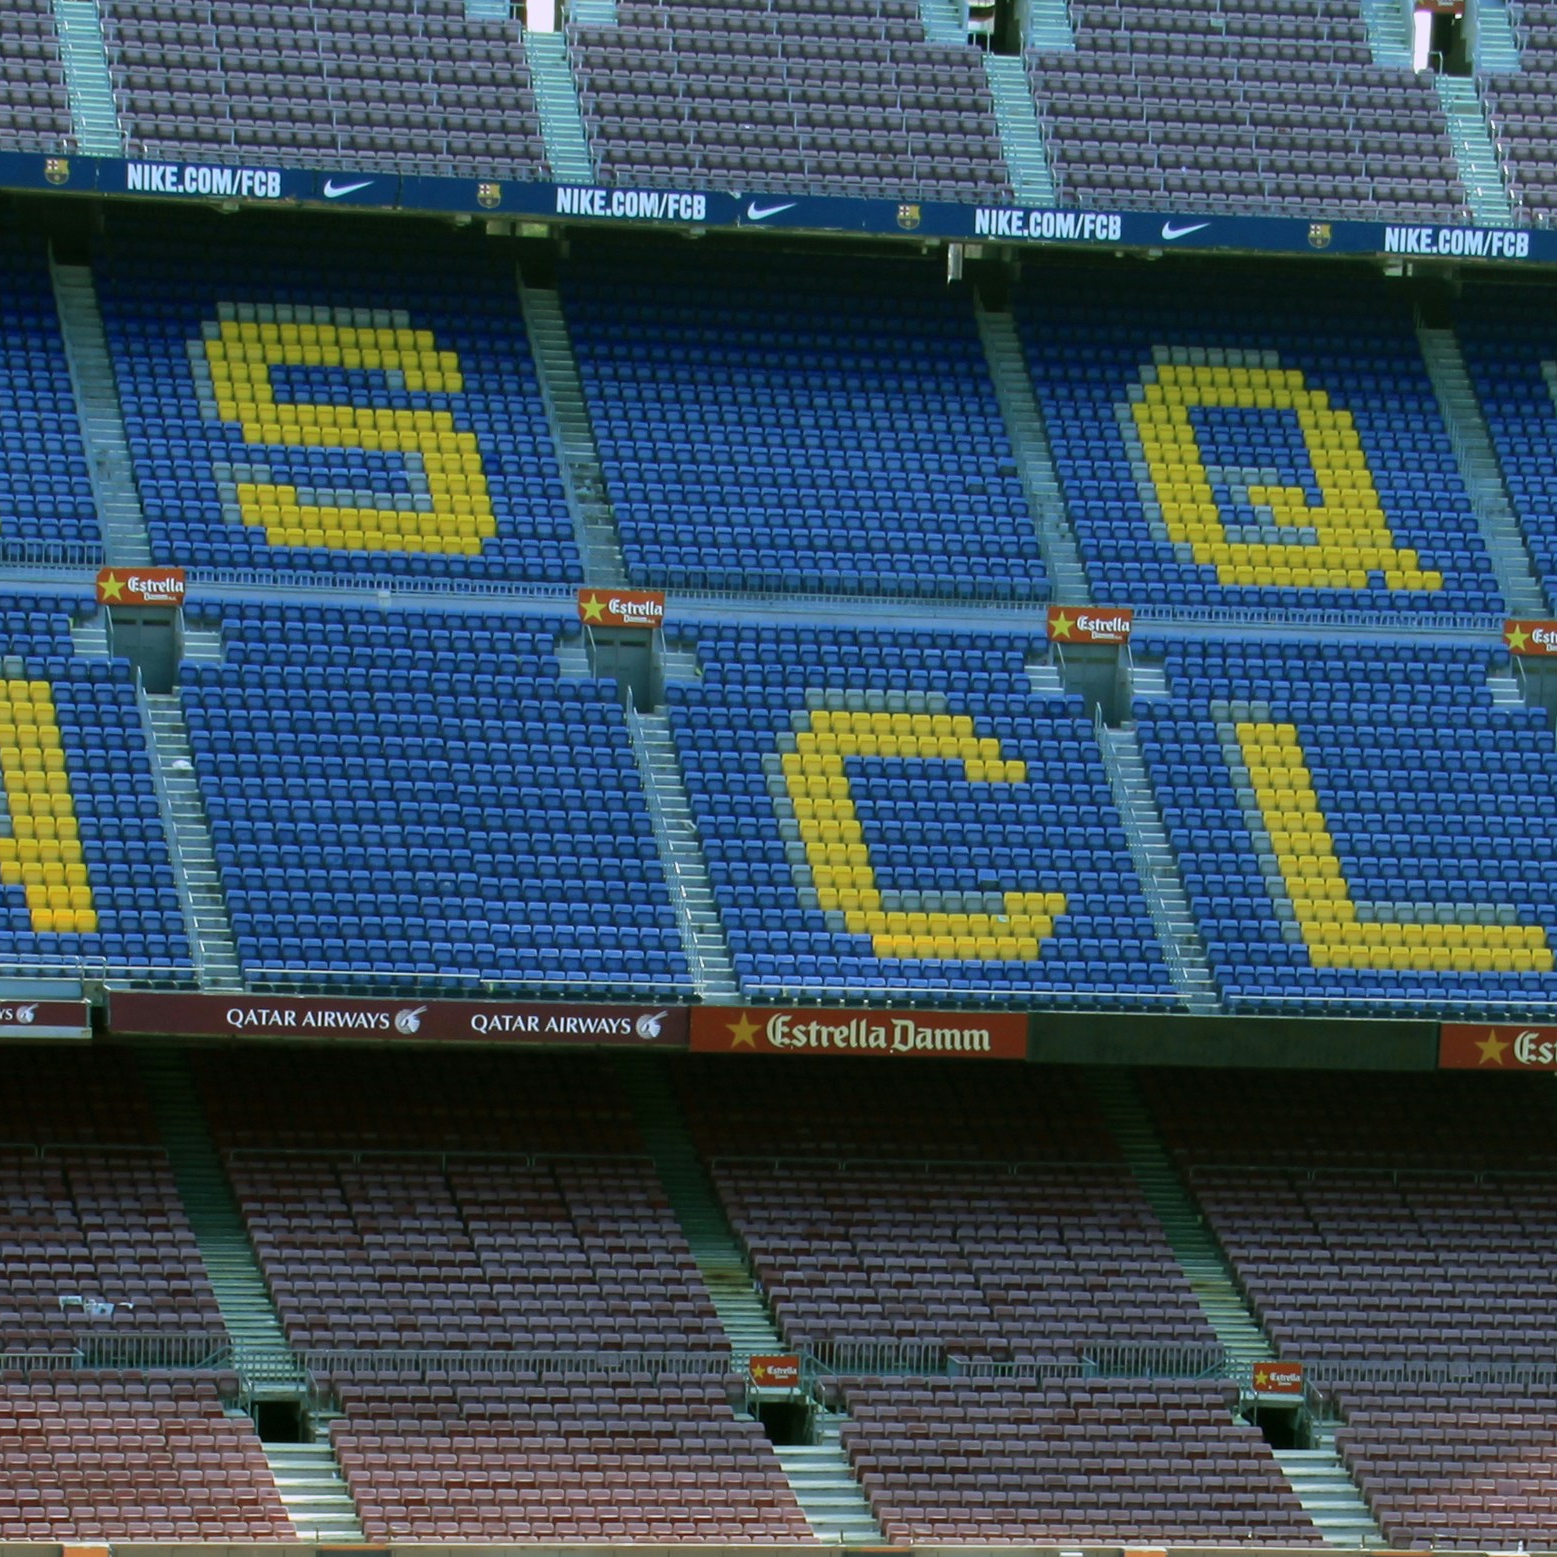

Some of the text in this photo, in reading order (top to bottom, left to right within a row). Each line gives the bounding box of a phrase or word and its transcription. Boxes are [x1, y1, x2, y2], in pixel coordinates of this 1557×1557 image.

[127, 163, 280, 197] NIKE.COM/FCB
[556, 187, 706, 220] NIKE.COM/FCB
[974, 209, 1121, 240] NIKE.COM/FCB
[1384, 227, 1529, 257] NIKE.COM/FCB
[128, 577, 184, 593] Estrella
[608, 598, 663, 616] Estrella
[1077, 616, 1130, 632] Estrella
[226, 1009, 390, 1029] QATAR AIRWAYS
[470, 1014, 632, 1034] QATAR AIRWAYS
[767, 1012, 991, 1053] Estrella Damm
